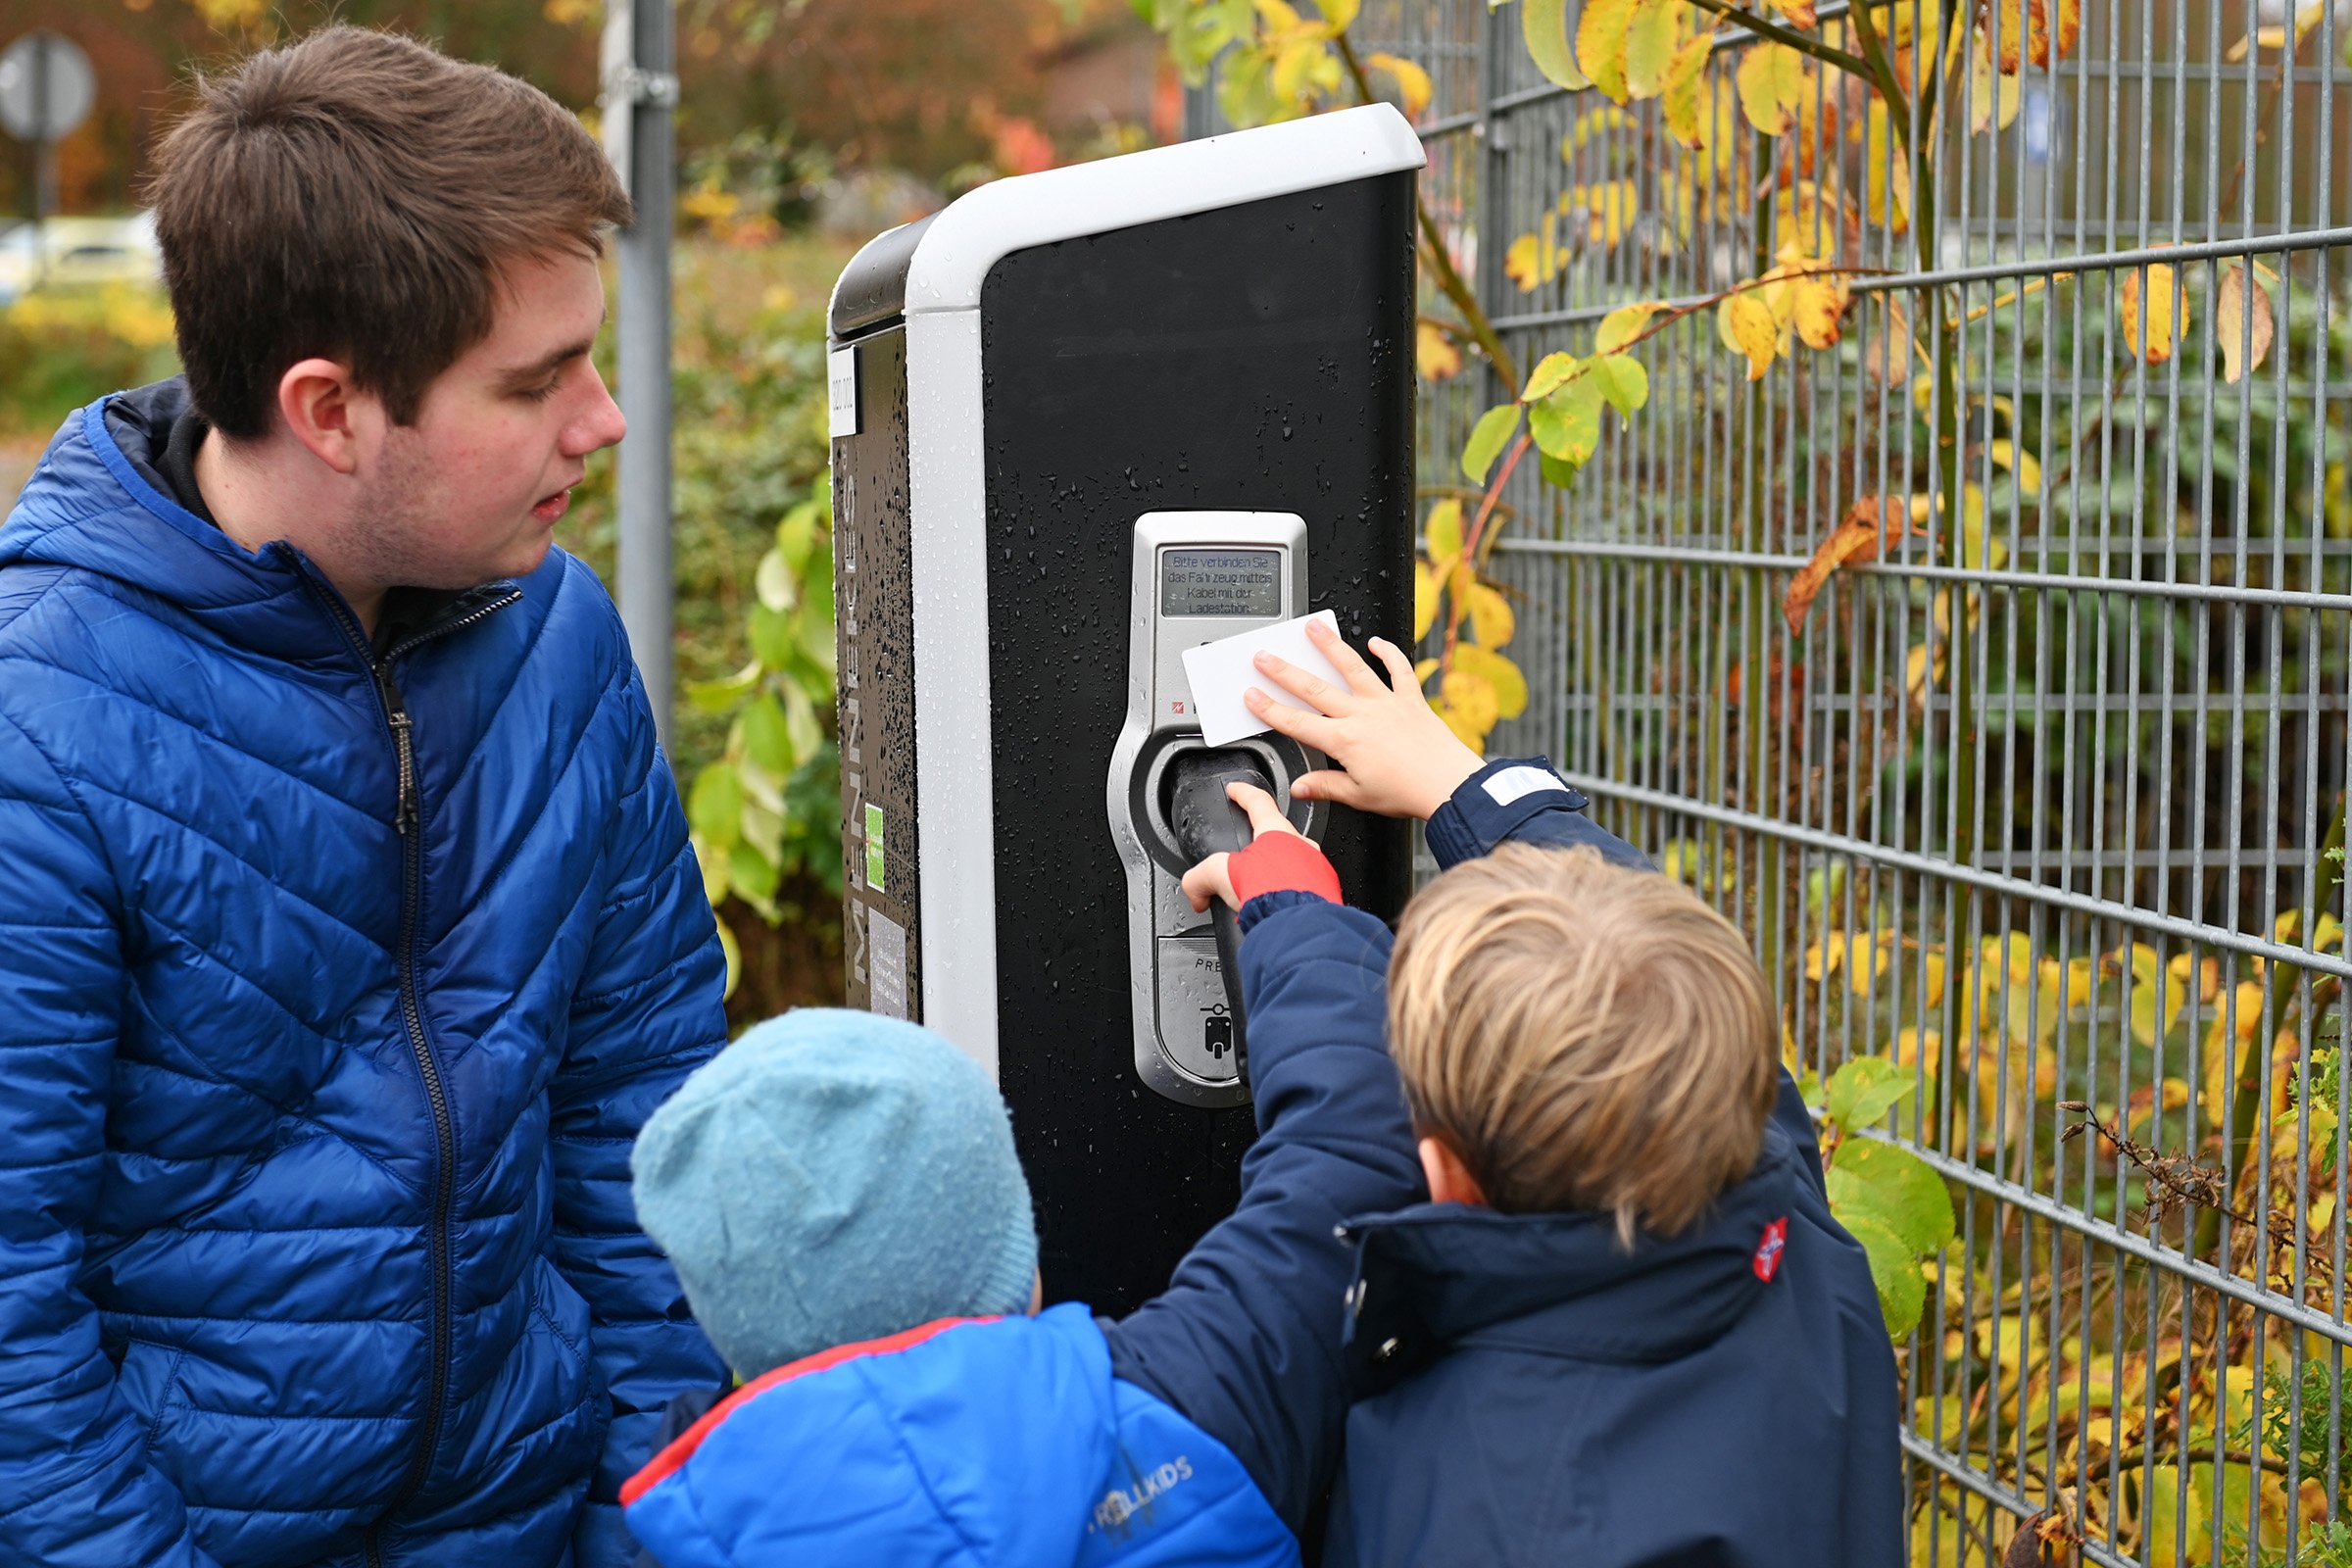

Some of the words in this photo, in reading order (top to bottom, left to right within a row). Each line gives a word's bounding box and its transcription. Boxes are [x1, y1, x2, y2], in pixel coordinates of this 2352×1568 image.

[1173, 556, 1199, 568] Bitte
[1200, 557, 1250, 568] verbinden
[1252, 557, 1268, 568] Sie
[1168, 571, 1187, 583] das
[1189, 571, 1238, 586] Fahrzeug
[1187, 587, 1216, 599] Kabel
[1218, 587, 1234, 599] mit
[1236, 587, 1251, 599] der
[1195, 958, 1222, 972] PRE
[1088, 1454, 1194, 1535] ROLLKIDS
